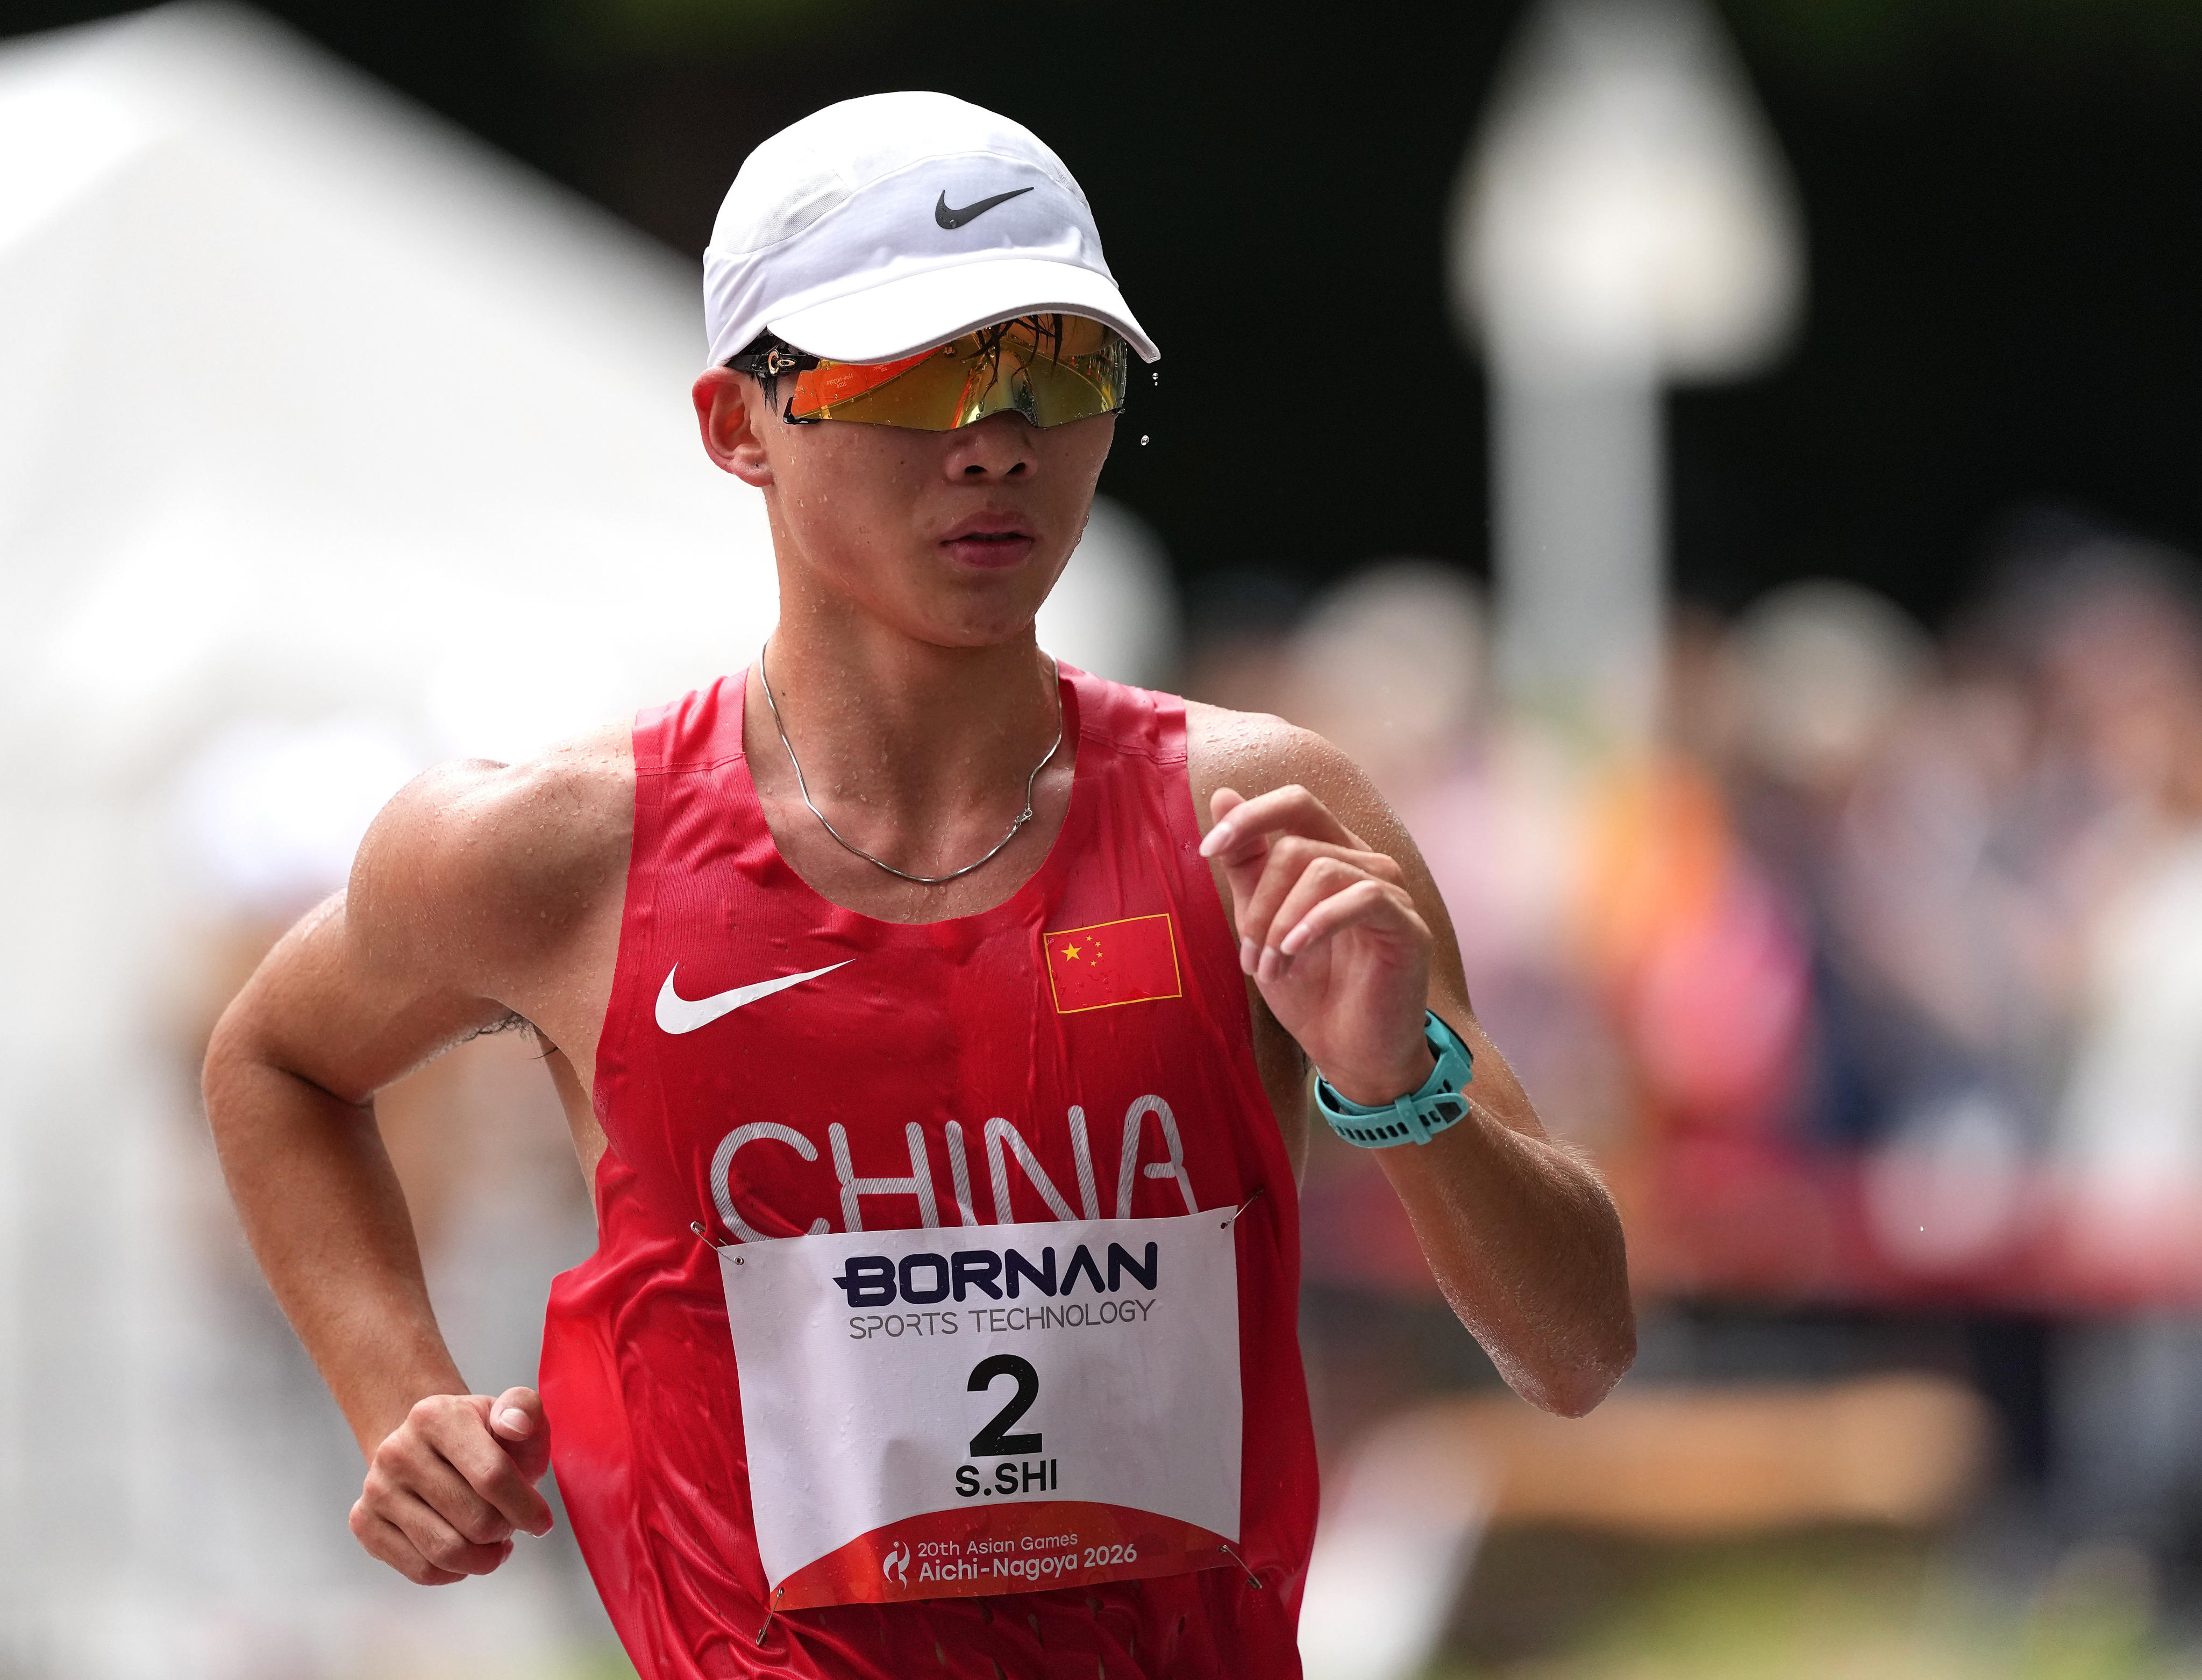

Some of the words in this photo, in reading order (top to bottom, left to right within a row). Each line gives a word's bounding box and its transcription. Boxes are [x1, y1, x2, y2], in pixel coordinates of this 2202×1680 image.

[710, 1094, 1198, 1242] CHINA
[832, 1241, 1158, 1308] BORNAN
[850, 1312, 958, 1339] SPORTS
[968, 1299, 1156, 1333] TECHNOLOGY
[967, 1354, 1043, 1457] 2
[955, 1459, 1057, 1497] S.SHI
[917, 1541, 960, 1557] 20th
[966, 1538, 1015, 1555] Asian
[1021, 1533, 1078, 1551] Games
[918, 1553, 1078, 1582] Aichi-Nagoya
[1084, 1543, 1138, 1568] 2026
